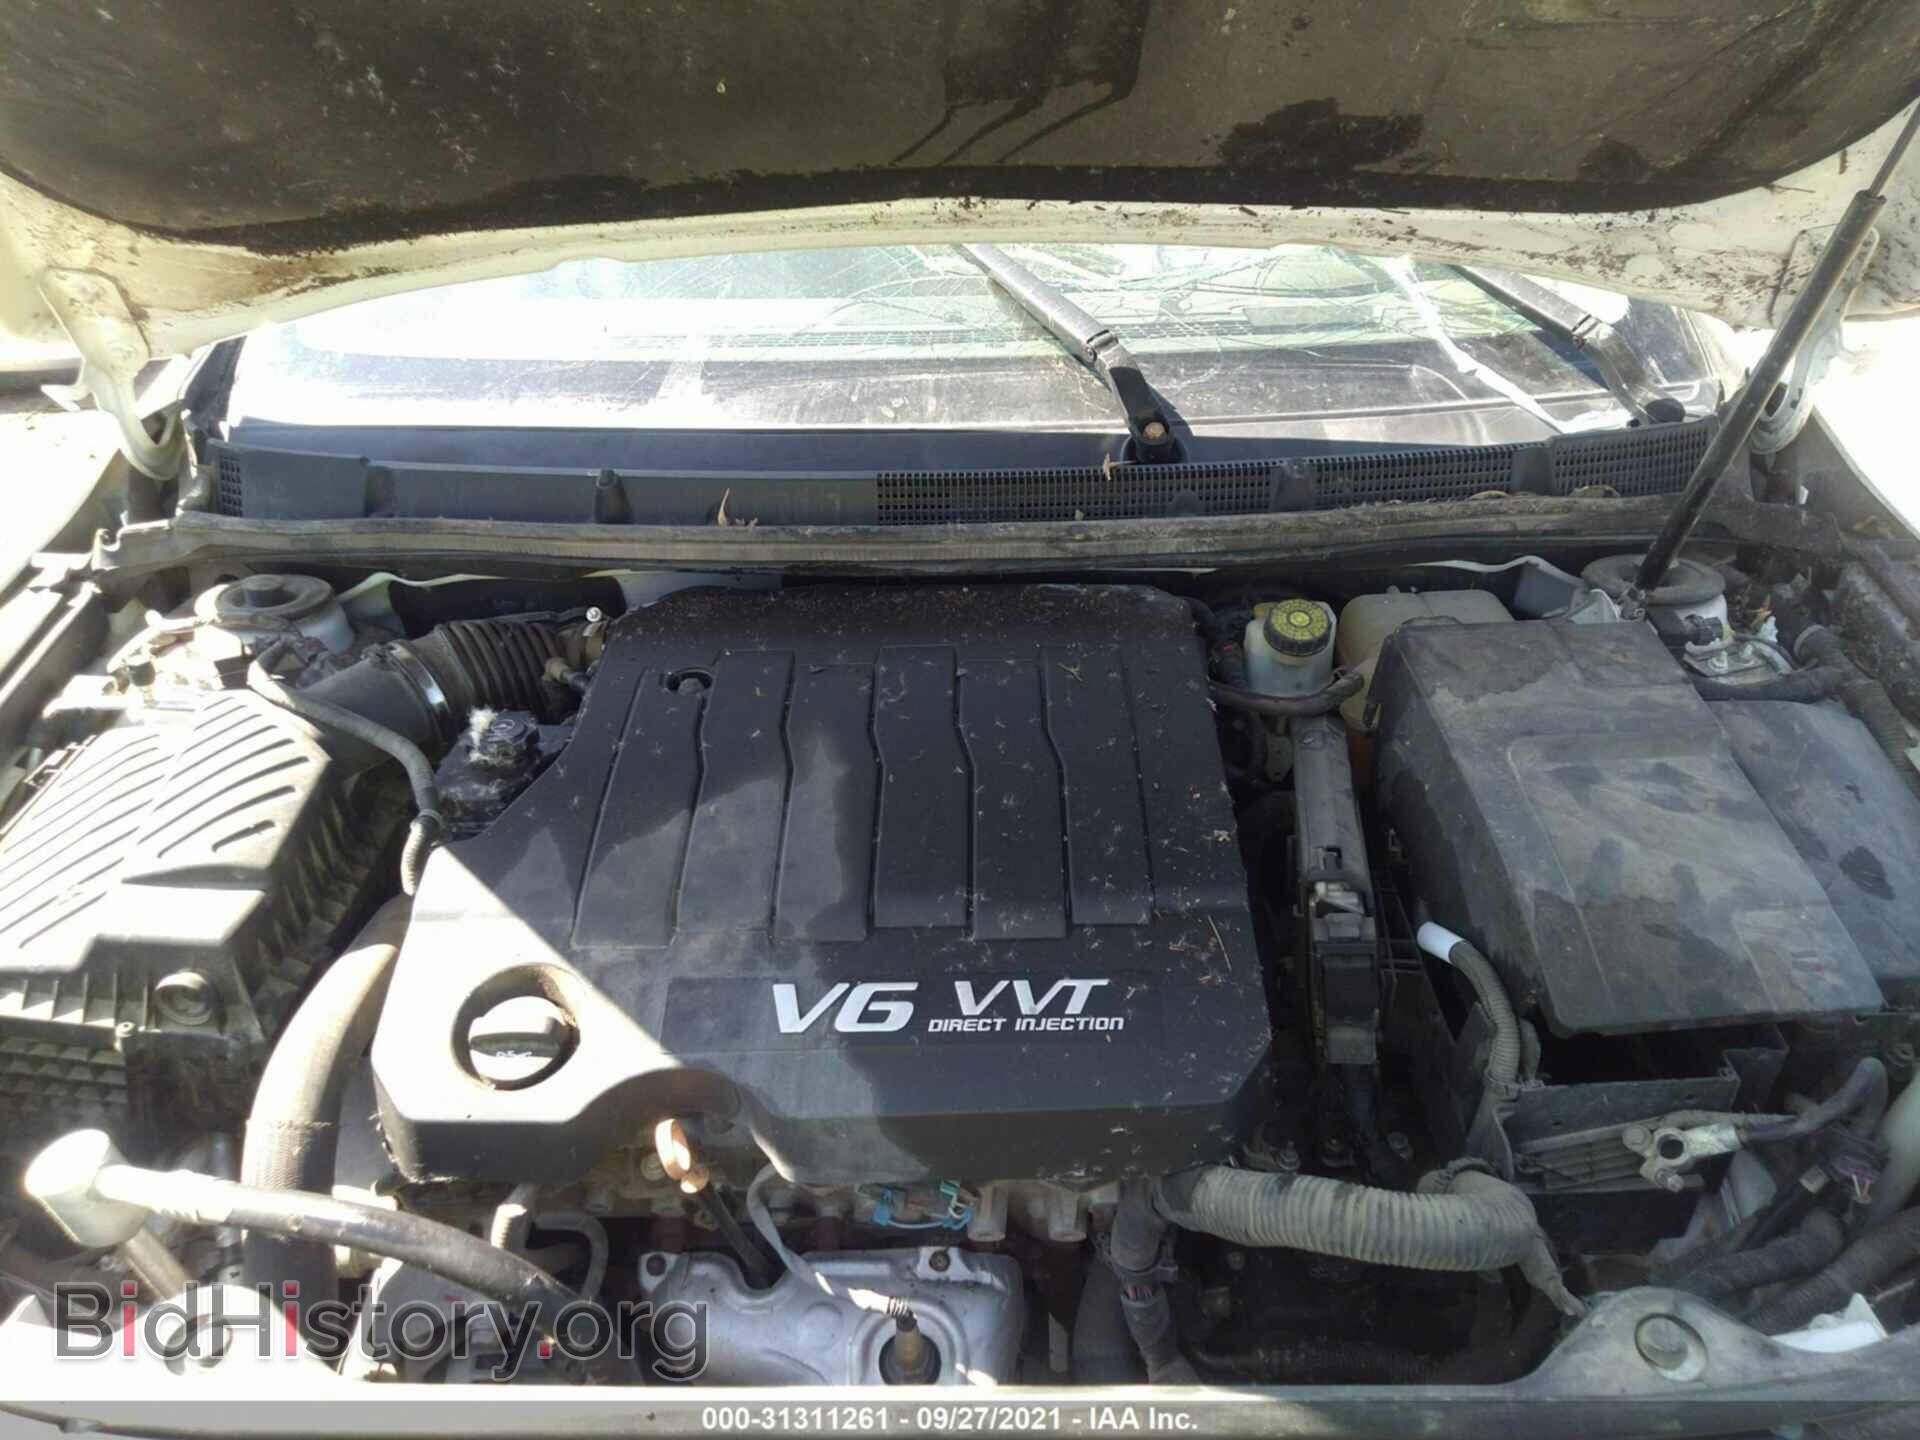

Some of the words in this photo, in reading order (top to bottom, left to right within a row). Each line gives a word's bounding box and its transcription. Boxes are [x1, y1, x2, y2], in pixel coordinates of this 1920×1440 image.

[772, 982, 919, 1033] V6
[954, 979, 1110, 1015] VVT
[928, 1018, 1007, 1032] DIRECT
[1015, 1017, 1124, 1031] INJECTION
